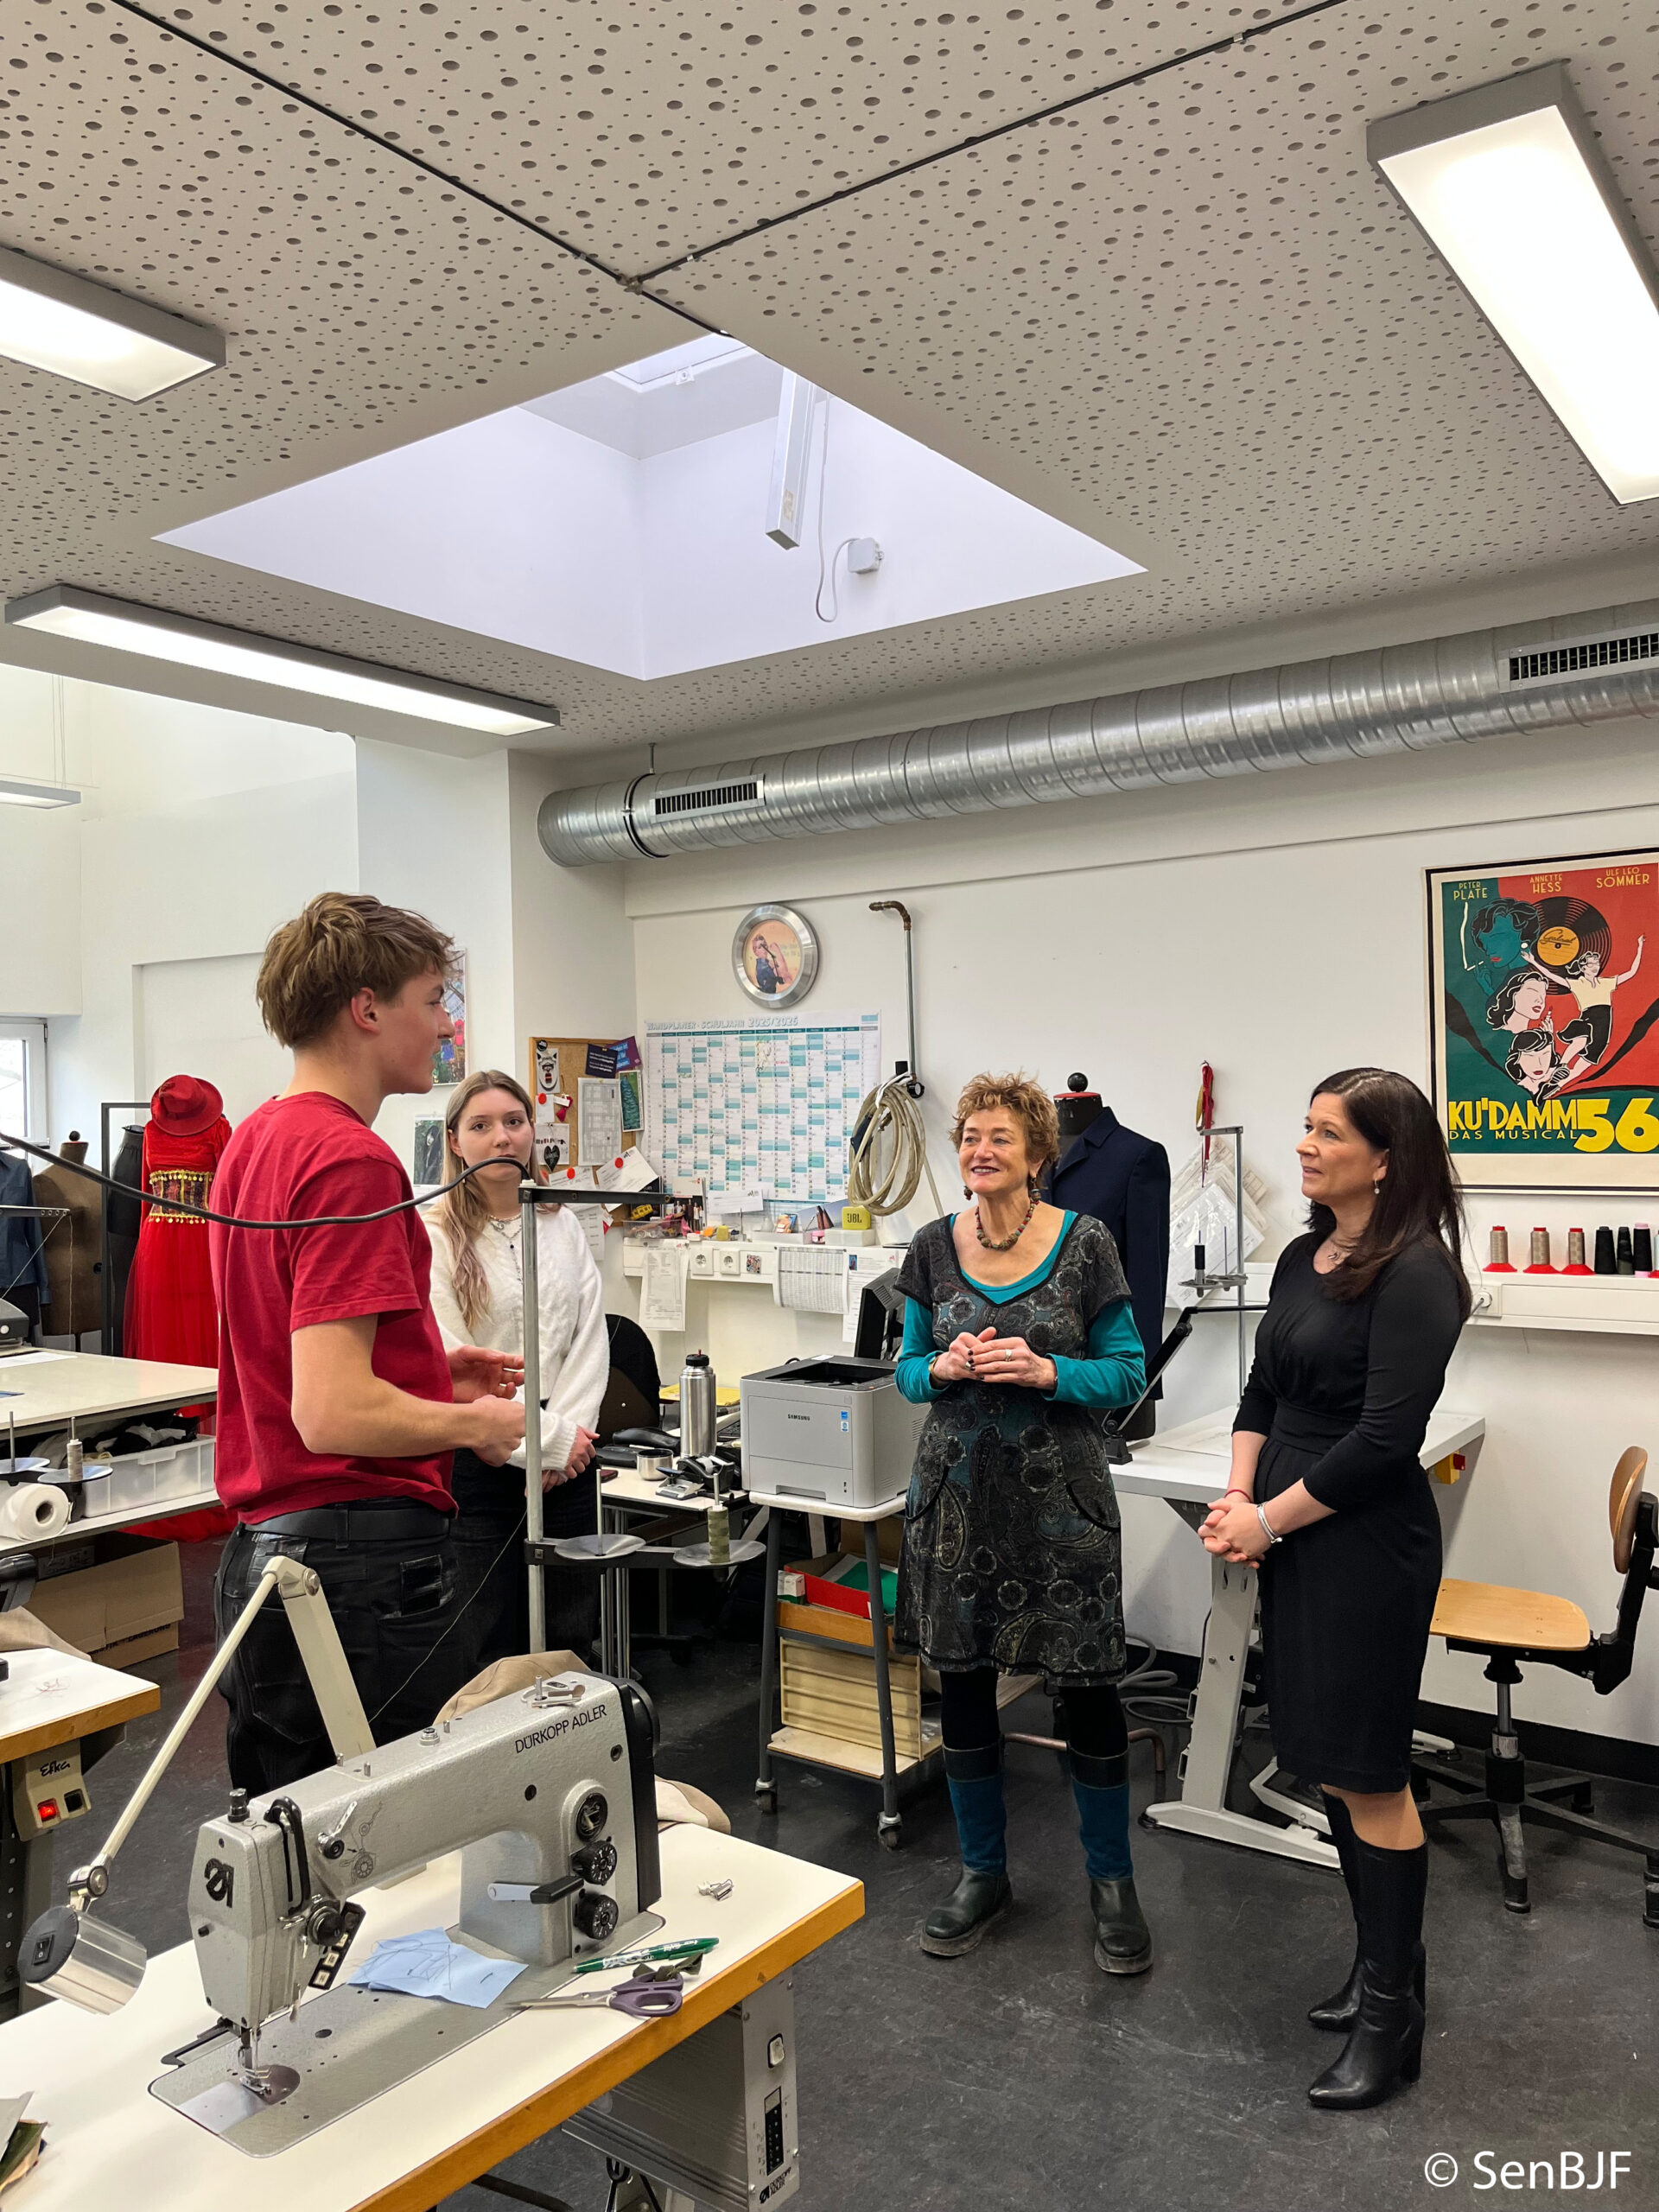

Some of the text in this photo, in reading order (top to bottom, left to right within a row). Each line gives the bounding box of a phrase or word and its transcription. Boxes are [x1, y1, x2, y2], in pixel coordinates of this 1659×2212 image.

[1529, 874, 1563, 883] ANNETTE
[1605, 867, 1640, 877] ULF LEO
[1532, 881, 1561, 894] HESS
[1596, 874, 1650, 888] SOMMER
[1453, 887, 1488, 901] PLATE
[1448, 1097, 1659, 1153] KU'DAMM 56
[1448, 1129, 1578, 1140] DAS MUSICAL
[847, 1212, 862, 1224] JBL
[515, 1704, 607, 1754] DÜRKOPP ADLER
